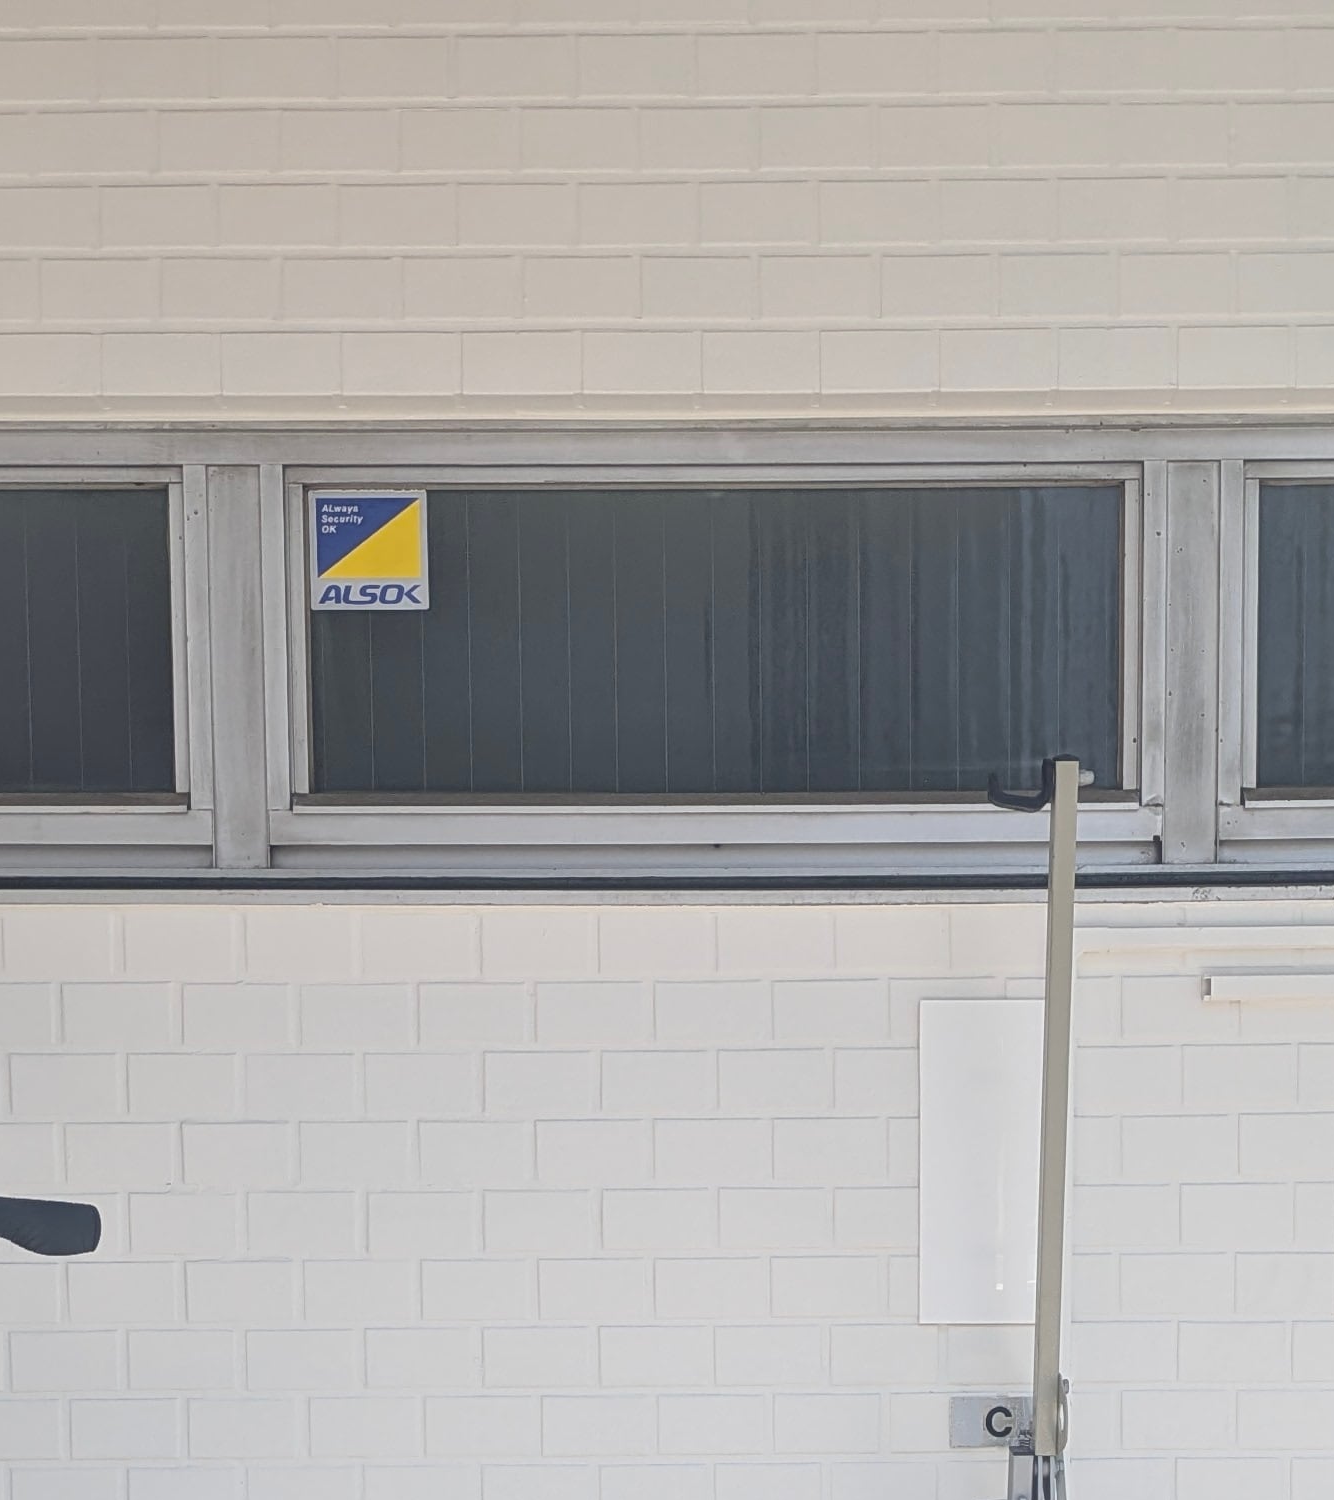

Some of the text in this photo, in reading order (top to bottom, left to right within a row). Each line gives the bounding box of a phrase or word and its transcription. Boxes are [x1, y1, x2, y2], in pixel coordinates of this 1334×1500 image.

[322, 515, 364, 525] Security
[322, 525, 337, 534] OK
[319, 584, 422, 605] ALSOK
[985, 1406, 1013, 1438] C
